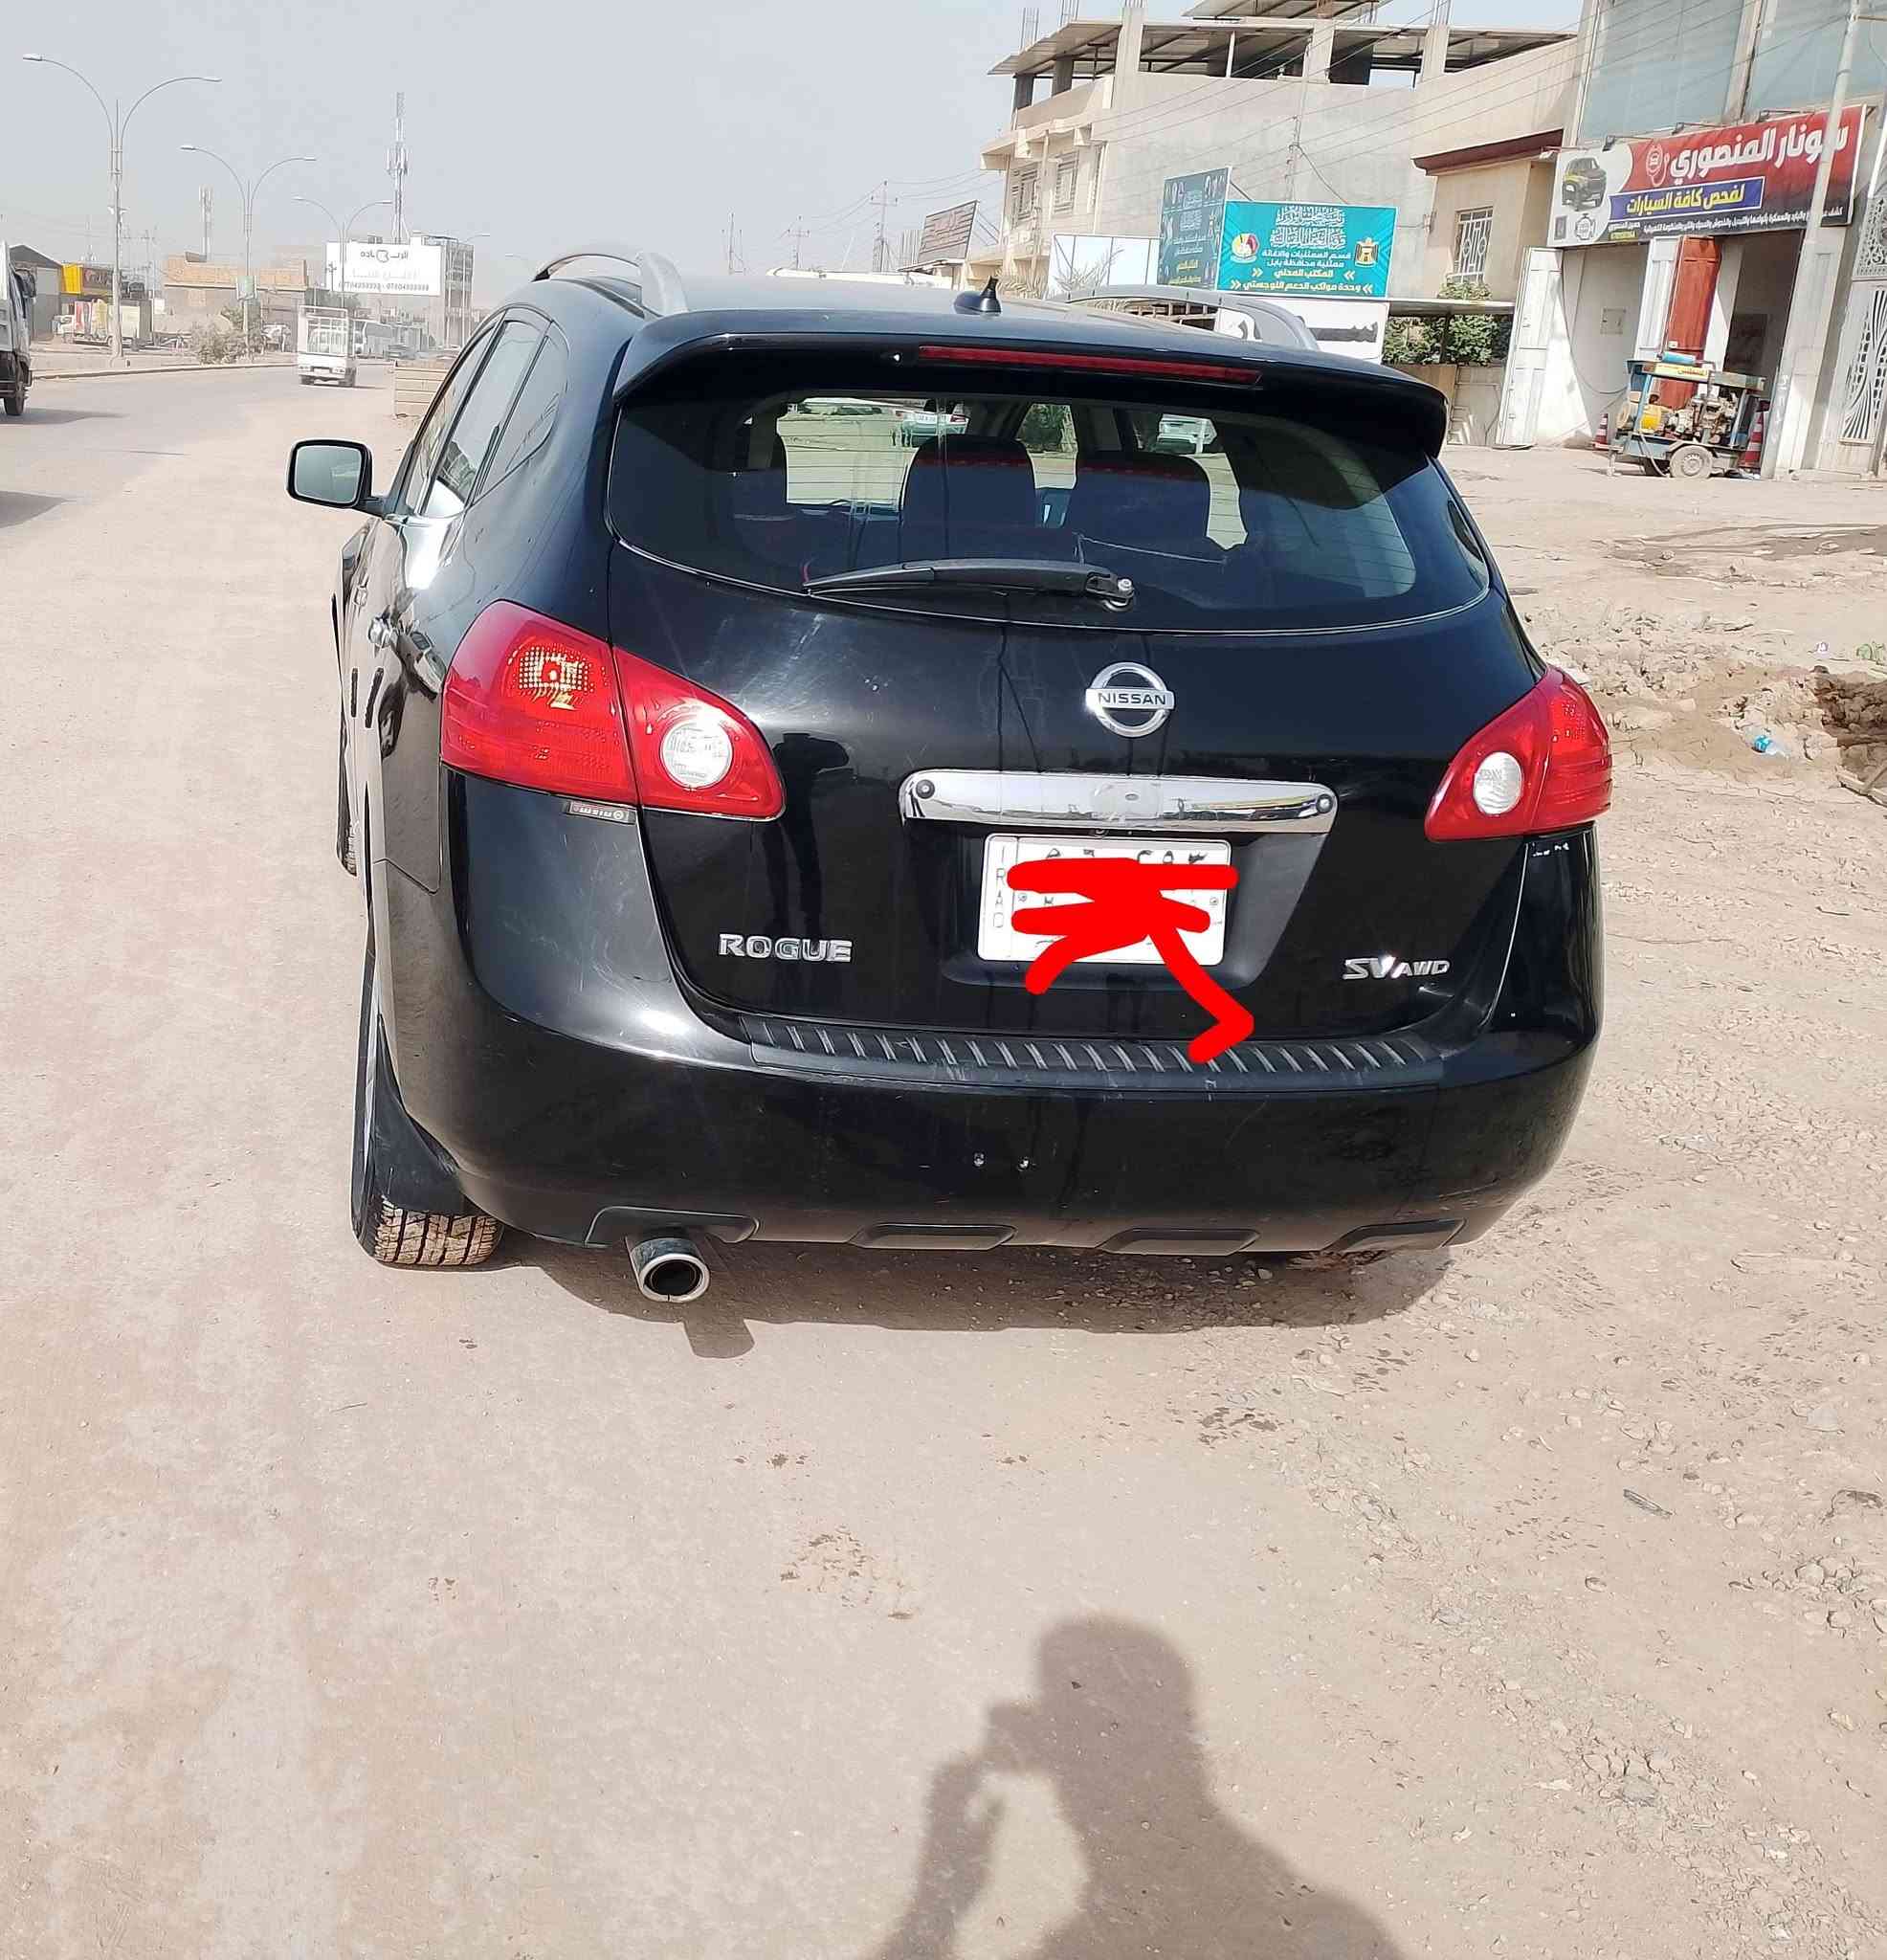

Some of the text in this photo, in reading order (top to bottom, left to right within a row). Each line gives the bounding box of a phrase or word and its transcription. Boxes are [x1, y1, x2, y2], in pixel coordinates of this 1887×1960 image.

[1670, 127, 1776, 185] المنصوري
[1627, 184, 1745, 216] لفحص كافة السيارات
[1097, 692, 1166, 705] NISSAN
[719, 933, 853, 963] ROGUE
[1343, 955, 1451, 979] SV AWD
